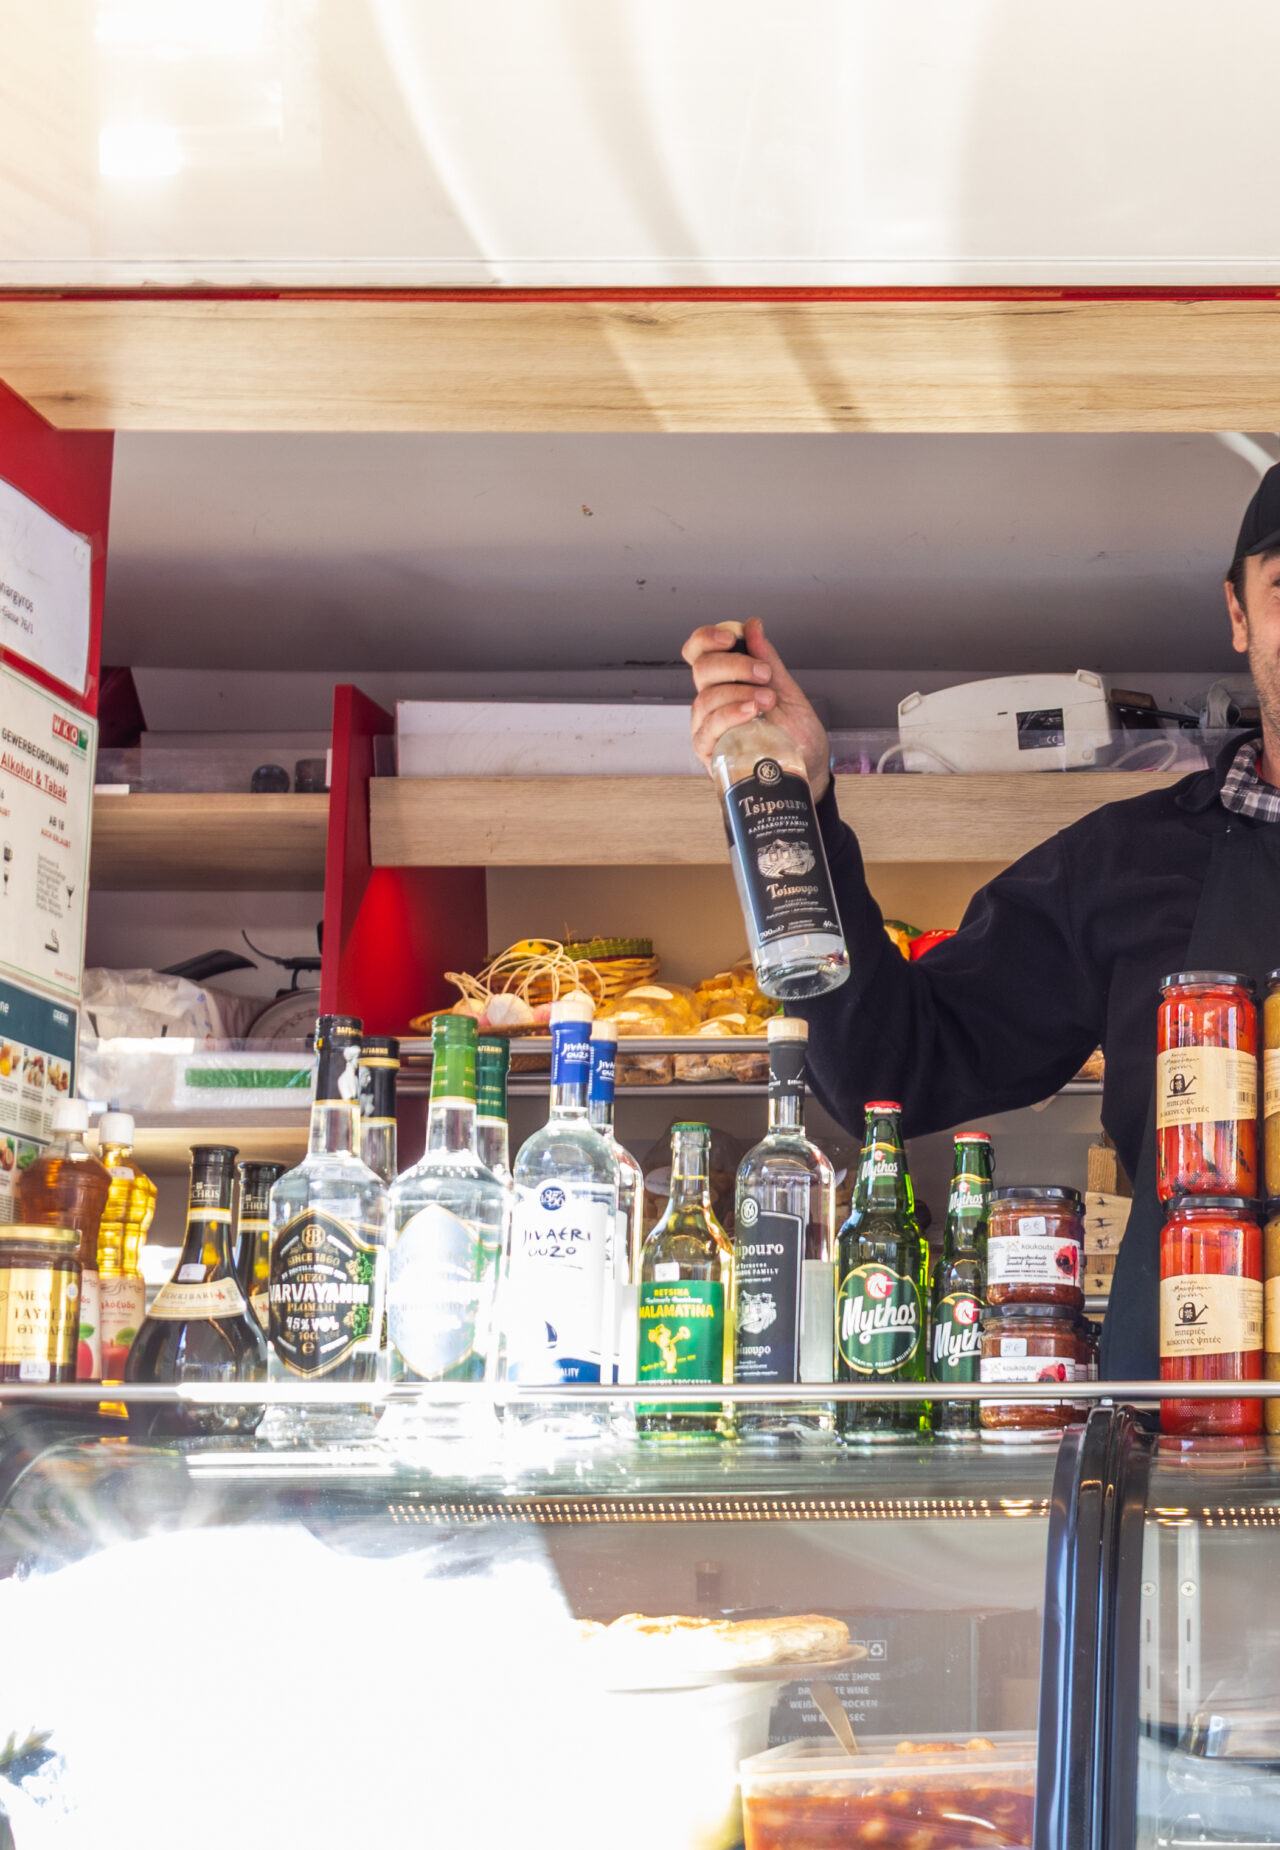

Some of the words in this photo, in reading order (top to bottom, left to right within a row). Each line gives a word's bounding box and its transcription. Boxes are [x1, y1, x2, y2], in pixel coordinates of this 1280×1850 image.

[52, 713, 79, 747] WKO
[1, 727, 70, 777] GEWERBEORDNUNG
[1, 751, 34, 783] Alkohol
[44, 773, 68, 801] Tabak
[739, 796, 809, 818] Tsipouro
[861, 1161, 898, 1181] Mythos
[949, 1191, 984, 1214] Mythos
[296, 1273, 327, 1283] OUZO
[753, 1267, 779, 1276] FAMILY
[842, 1296, 917, 1345] Mythos
[847, 1686, 870, 1695] WINE
[802, 1713, 817, 1722] VIN
[849, 1713, 865, 1722] SEC
